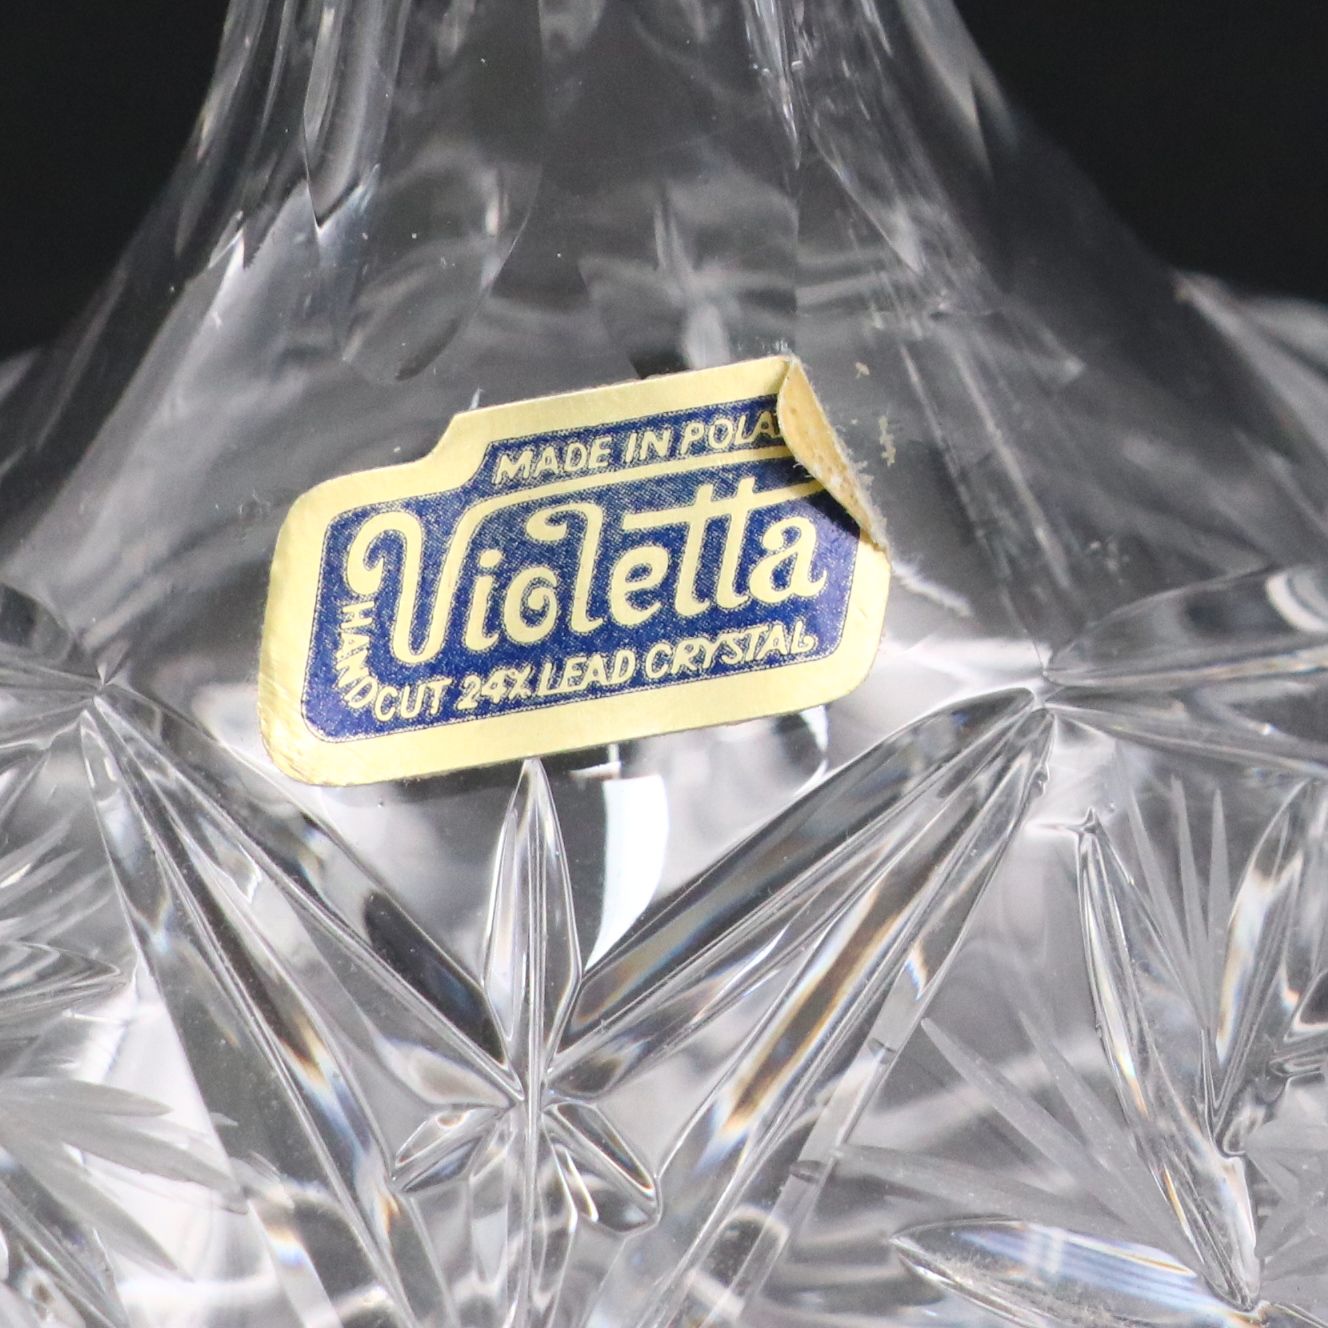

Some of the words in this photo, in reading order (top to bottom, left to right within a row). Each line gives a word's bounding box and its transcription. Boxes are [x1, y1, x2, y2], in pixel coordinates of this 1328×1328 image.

[493, 435, 611, 484] MADE
[623, 427, 672, 459] IN
[680, 410, 783, 455] POLA
[345, 477, 828, 664] Violetta
[335, 600, 379, 710] HAND
[374, 676, 453, 722] CUT
[537, 649, 637, 697] LEAD
[644, 621, 819, 677] CRYSTAL
